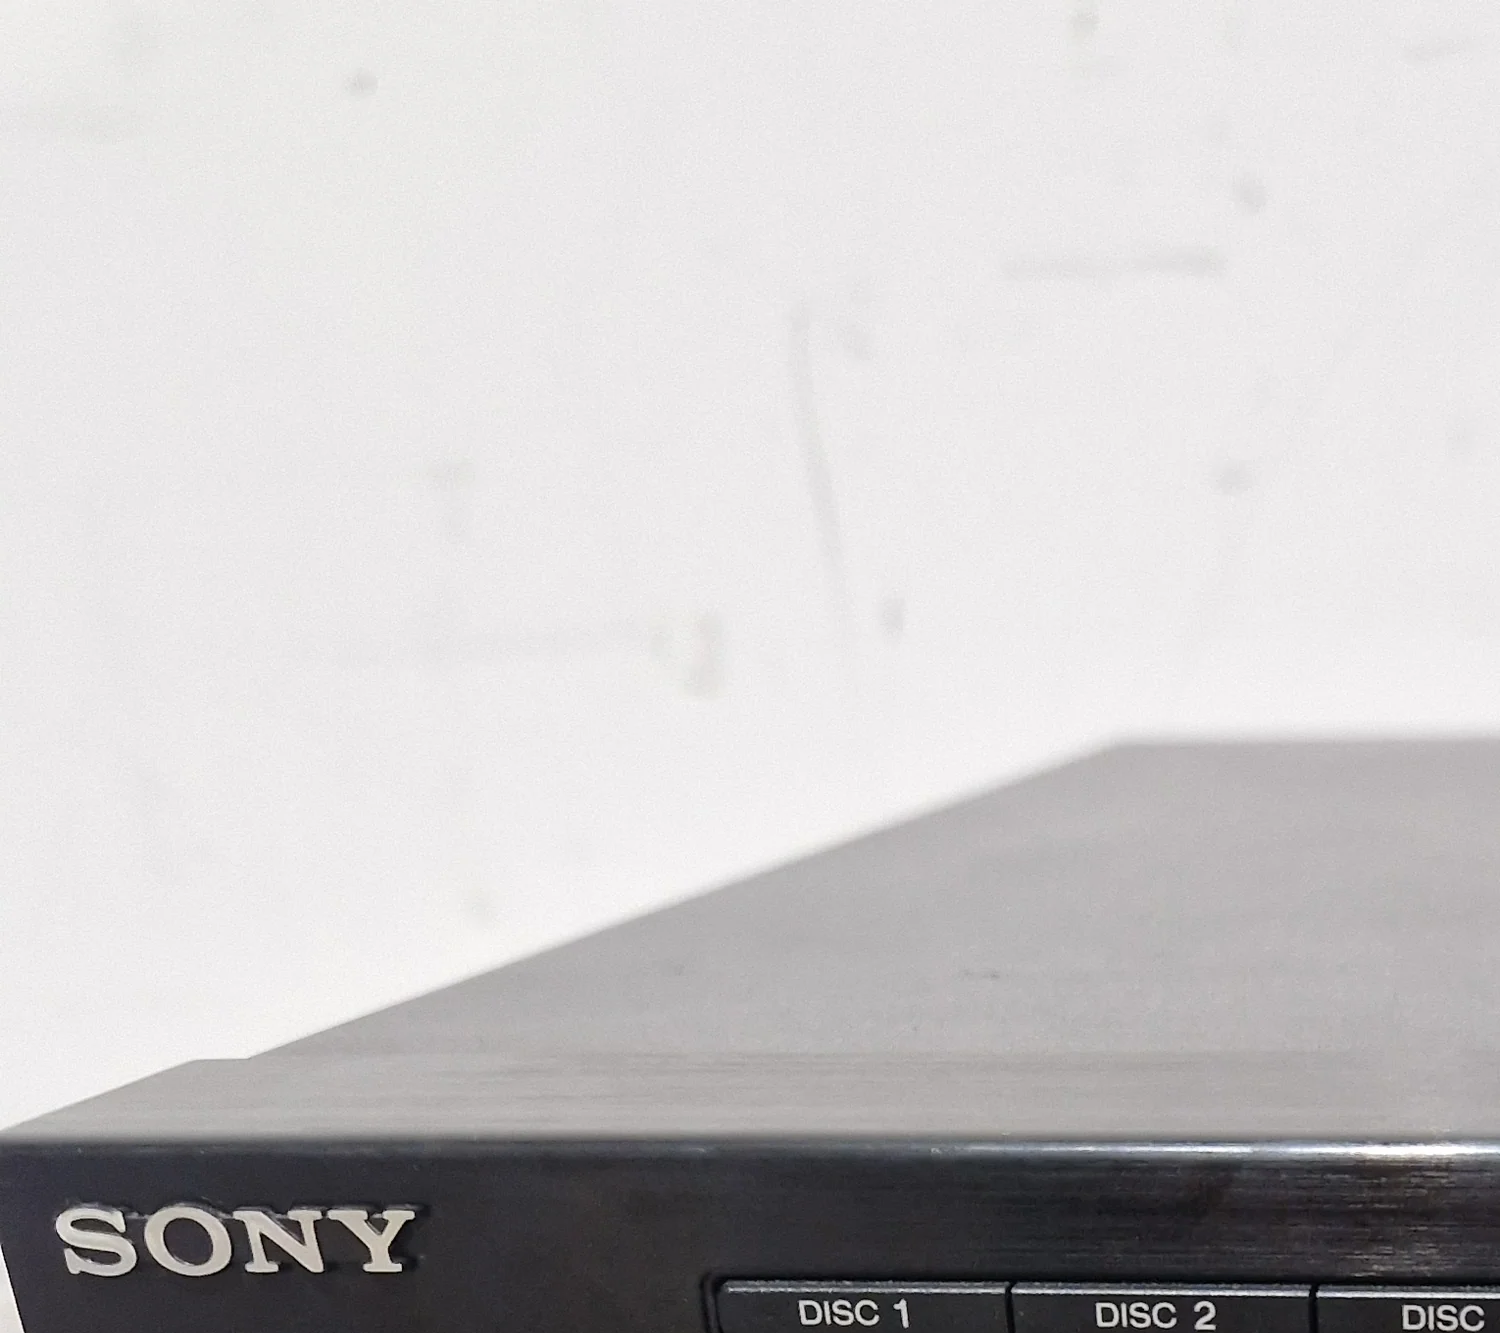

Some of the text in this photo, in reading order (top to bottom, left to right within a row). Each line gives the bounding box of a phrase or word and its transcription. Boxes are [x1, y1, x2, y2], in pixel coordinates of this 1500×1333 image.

[55, 1206, 416, 1277] SONY
[798, 1298, 909, 1329] DISC 1
[1095, 1300, 1217, 1331] DISC 2
[1402, 1304, 1485, 1332] DISC
